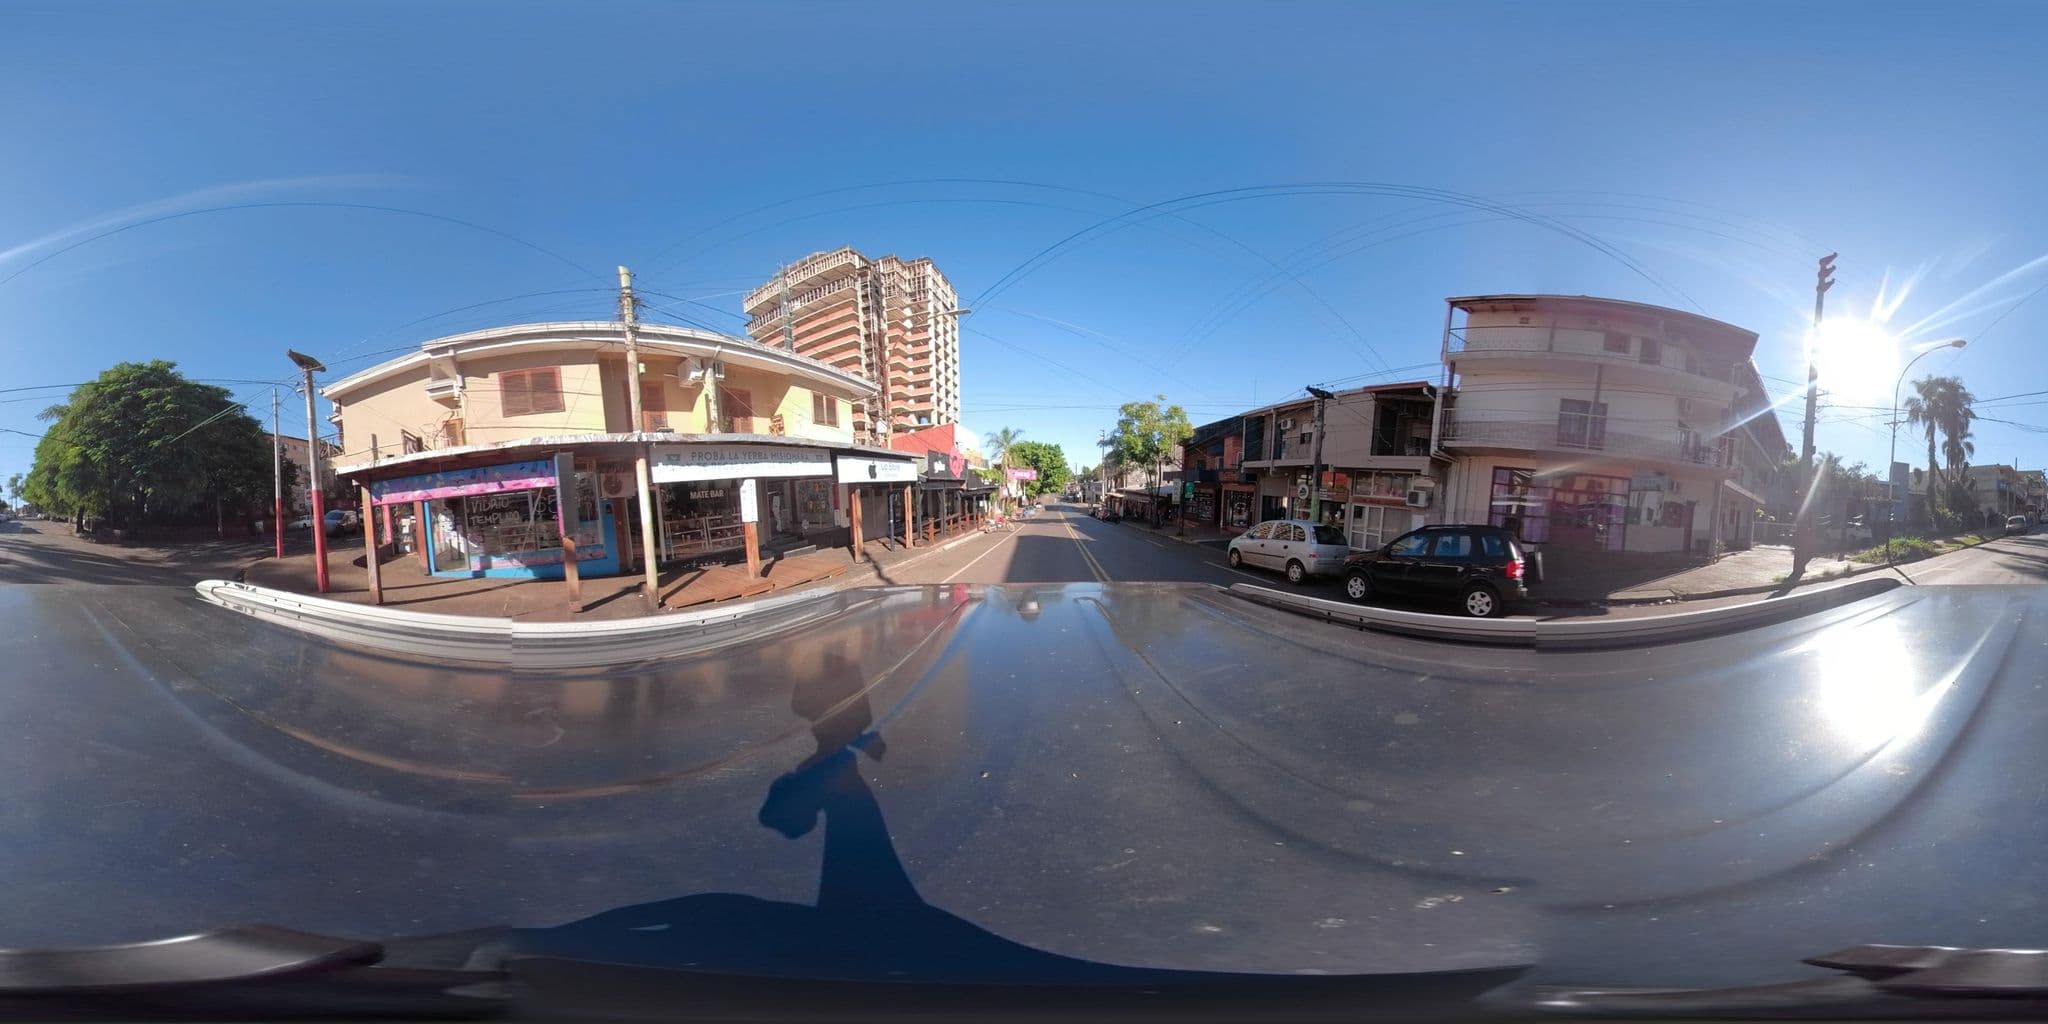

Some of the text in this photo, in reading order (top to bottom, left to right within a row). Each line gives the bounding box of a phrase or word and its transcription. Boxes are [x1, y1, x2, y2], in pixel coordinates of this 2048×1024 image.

[728, 451, 739, 461] LA
[690, 489, 724, 499] MATE BAR
